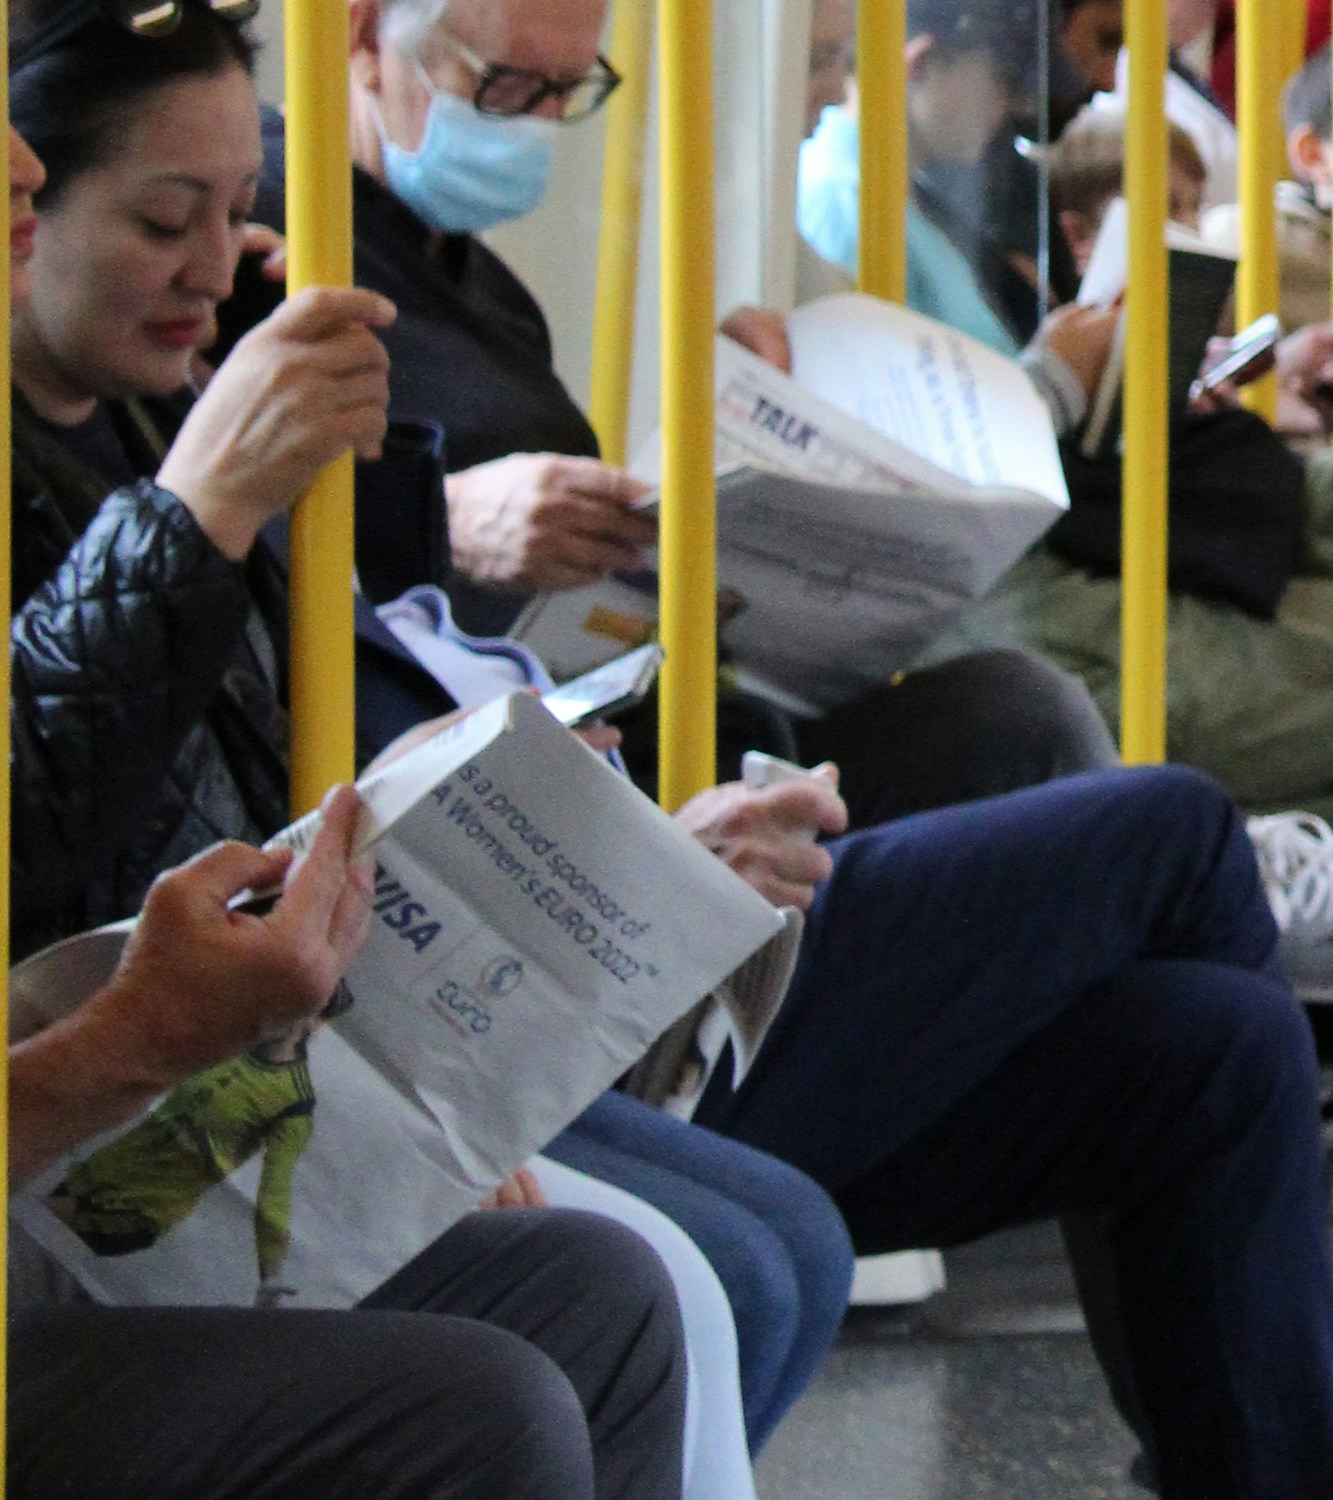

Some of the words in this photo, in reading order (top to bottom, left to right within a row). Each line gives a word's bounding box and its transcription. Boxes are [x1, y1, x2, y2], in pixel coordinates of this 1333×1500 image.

[748, 395, 820, 451] TALK
[473, 778, 494, 797] a
[483, 793, 558, 857] proud
[446, 796, 541, 896] Women's
[533, 885, 599, 945] EURO
[545, 853, 626, 923] sponsor
[373, 860, 443, 954] VISA
[619, 918, 652, 939] of
